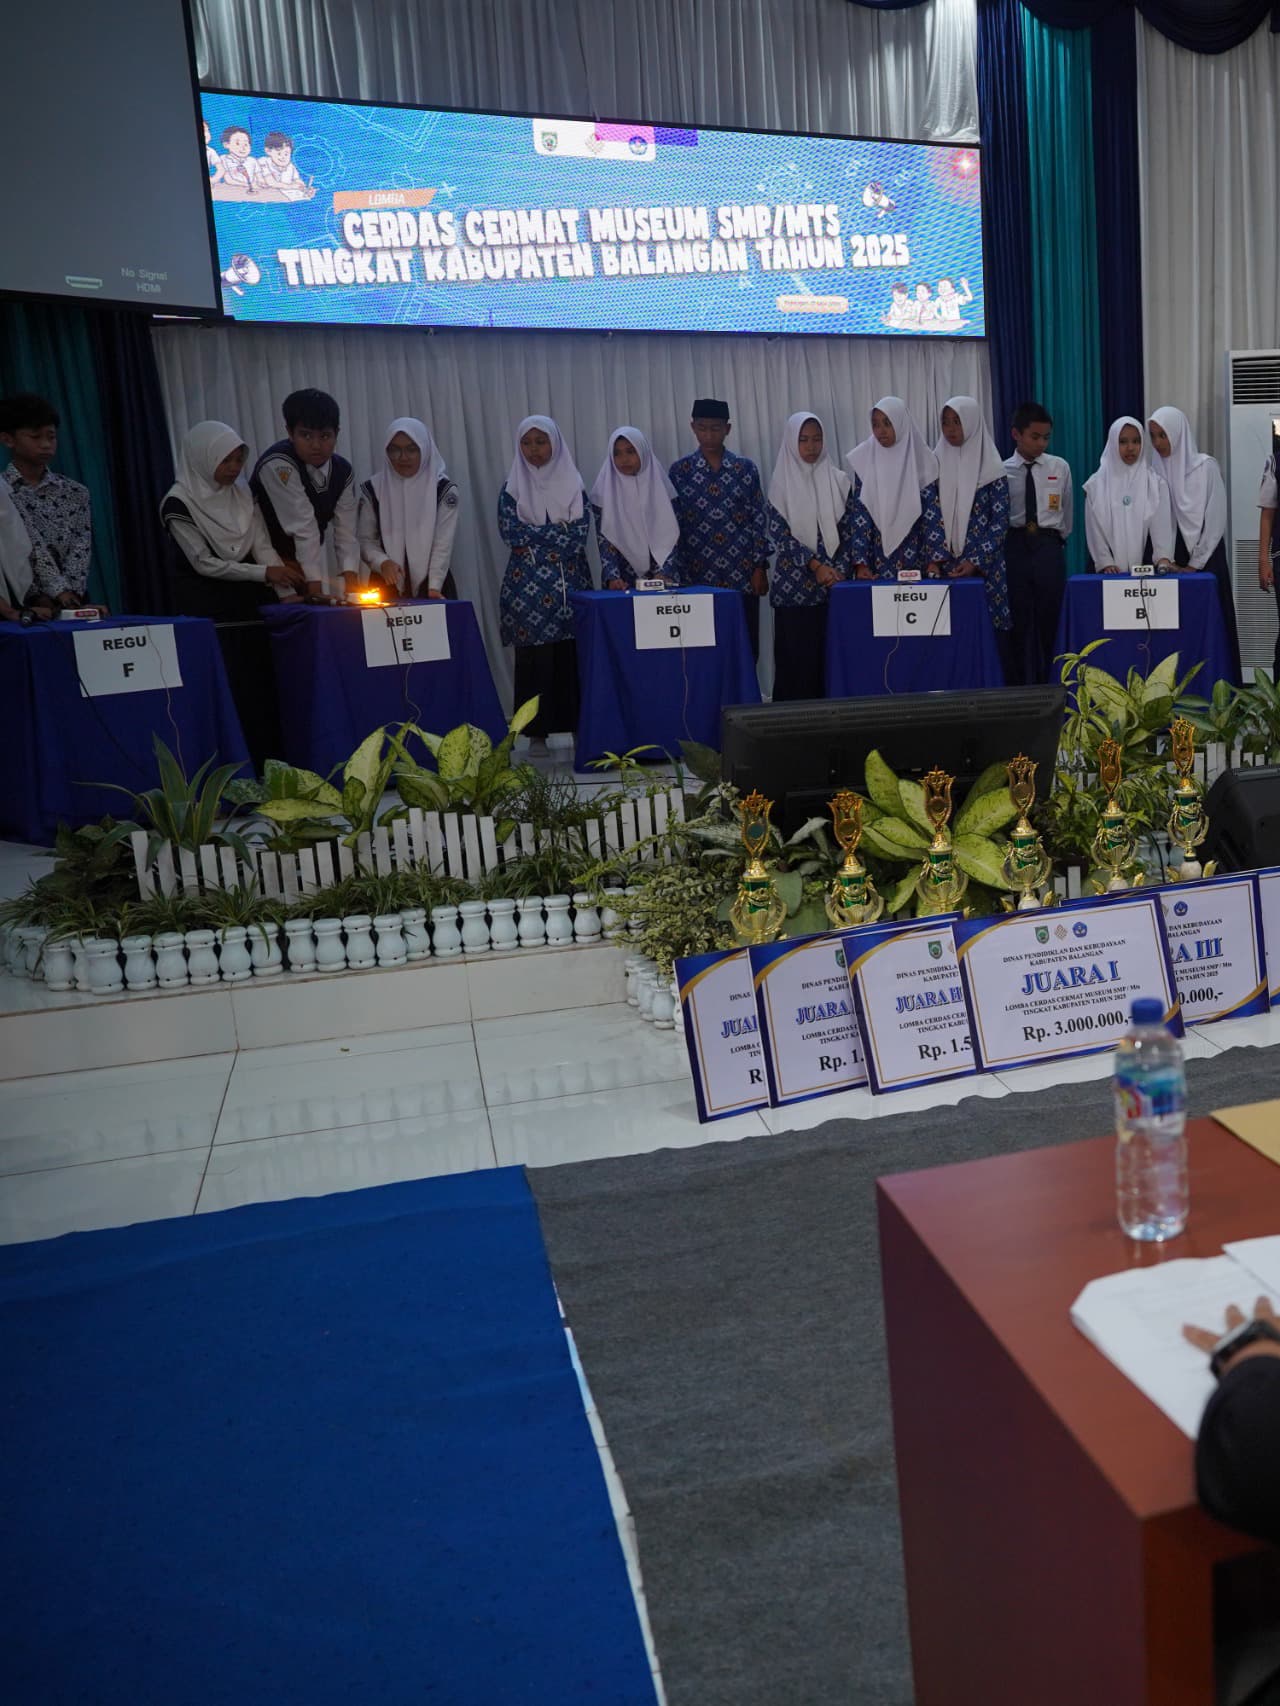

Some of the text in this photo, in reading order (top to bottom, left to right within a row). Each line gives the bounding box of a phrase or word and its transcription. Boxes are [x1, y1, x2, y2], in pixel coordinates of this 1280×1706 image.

[368, 193, 406, 205] LOMBA
[343, 204, 841, 249] CERDAS CERMAT MUSEUM SMP/MTS
[279, 234, 911, 286] TINGKAT KABUPATEN BALANGAN TAHUN 2025
[120, 267, 168, 282] No Signal
[136, 282, 161, 294] HDMI
[893, 592, 928, 603] REGU
[1124, 587, 1157, 598] REGU
[656, 604, 691, 616] REGU
[1135, 608, 1147, 620] B
[386, 613, 423, 629] REGU
[905, 612, 917, 625] C
[669, 626, 681, 639] D
[102, 634, 148, 652] REGU
[402, 638, 414, 653] E
[123, 662, 136, 678] F
[1182, 918, 1223, 929] KEBUDAYAAN
[1167, 928, 1201, 938] BALANGAN
[1003, 954, 1023, 963] DINAS
[1069, 944, 1083, 953] DAN
[1084, 939, 1126, 950] KEBUDAYAAN
[1195, 937, 1224, 960] III
[1029, 950, 1104, 967] KABUPATEN BALANGAN
[896, 964, 958, 980] DINAS PENDIDIKLA
[1179, 965, 1207, 975] MUSEUM
[1207, 963, 1219, 971] SMP
[1185, 972, 1206, 982] TAHUN
[1206, 970, 1219, 978] 2025
[801, 975, 848, 990] DINAS PENDID
[923, 971, 959, 983] KABUPATE
[1021, 960, 1121, 995] JUARA I
[828, 982, 850, 992] KABU
[729, 991, 751, 1001] DINAS
[895, 989, 950, 1014] JUARA
[1005, 1002, 1029, 1012] LOMBA
[1029, 998, 1056, 1008] CERDAS
[1056, 994, 1084, 1003] CERMAT
[1084, 989, 1113, 998] MUSEUM
[1113, 986, 1126, 994] SMP
[1178, 986, 1224, 1006] 0.000,-
[796, 999, 851, 1025] JUARA
[1023, 993, 1127, 1016] TINGKAT KABUPATEN TAHUN 2025
[720, 1014, 759, 1039] JUA
[899, 1011, 967, 1030] LOMBA CERDAS CER
[918, 1019, 969, 1034] TINGKAT KABU
[1022, 1010, 1134, 1043] Rp. 3.000.000,-
[801, 1031, 826, 1041] LOMBA
[827, 1024, 853, 1035] CERDAS
[819, 1033, 849, 1045] TINGKAT
[730, 1043, 755, 1054] LOMBA
[918, 1035, 972, 1061] Rp. 1.5
[819, 1049, 864, 1072] Rp. 1.
